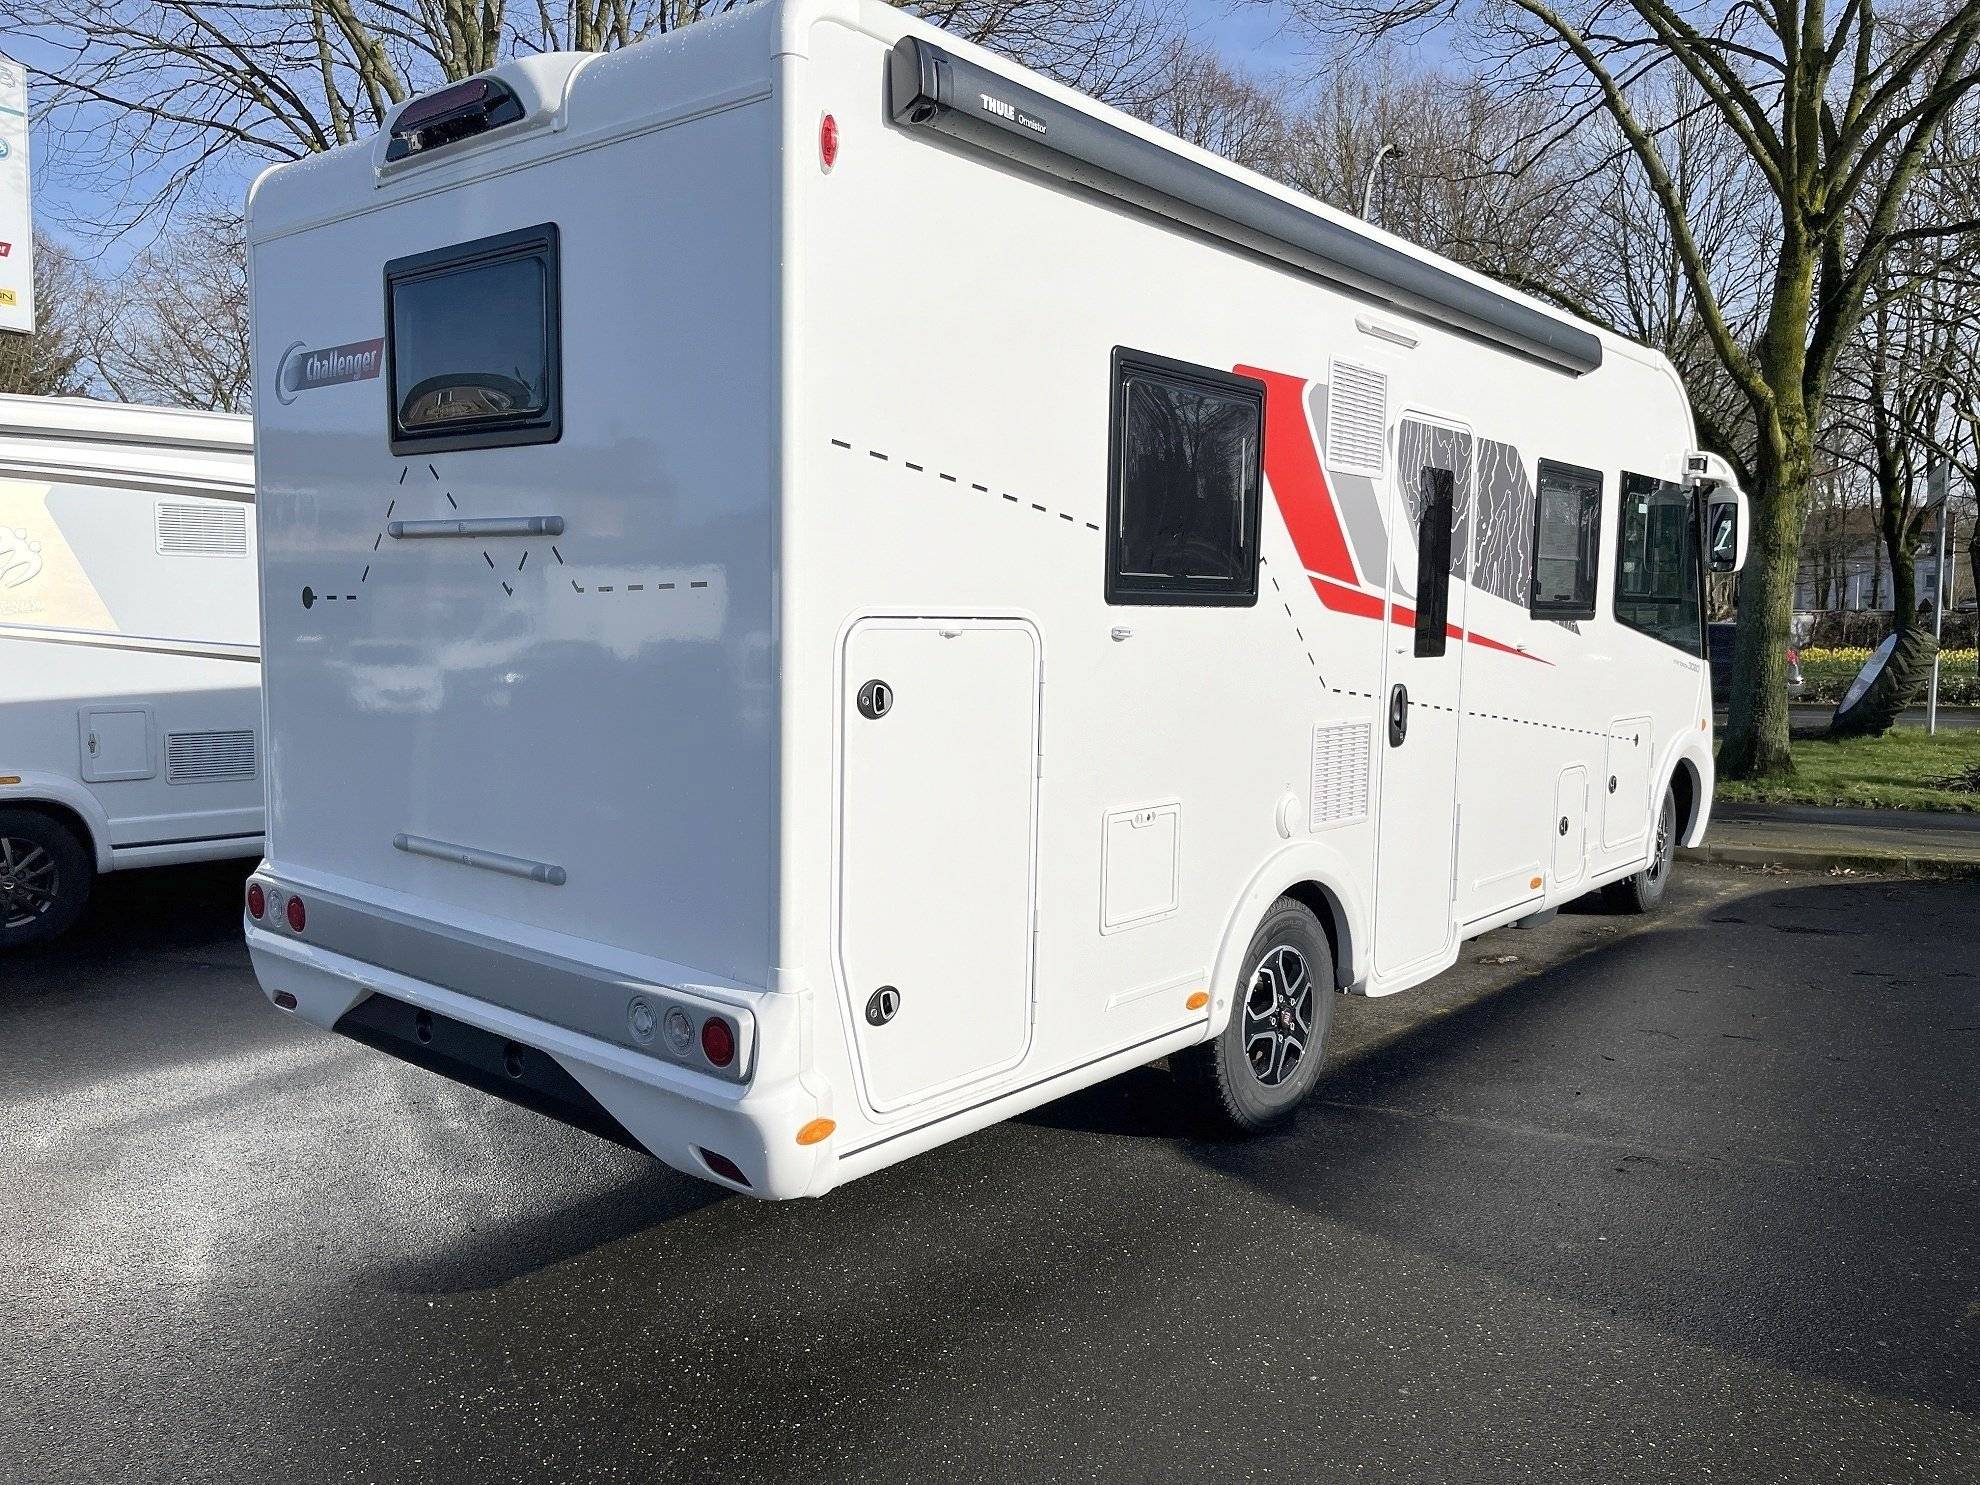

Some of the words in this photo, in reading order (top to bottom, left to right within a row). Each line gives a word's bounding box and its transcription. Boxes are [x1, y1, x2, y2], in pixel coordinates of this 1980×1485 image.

[980, 94, 1015, 121] THULE
[1018, 114, 1047, 134] Omnistor
[306, 350, 377, 381] Challenger
